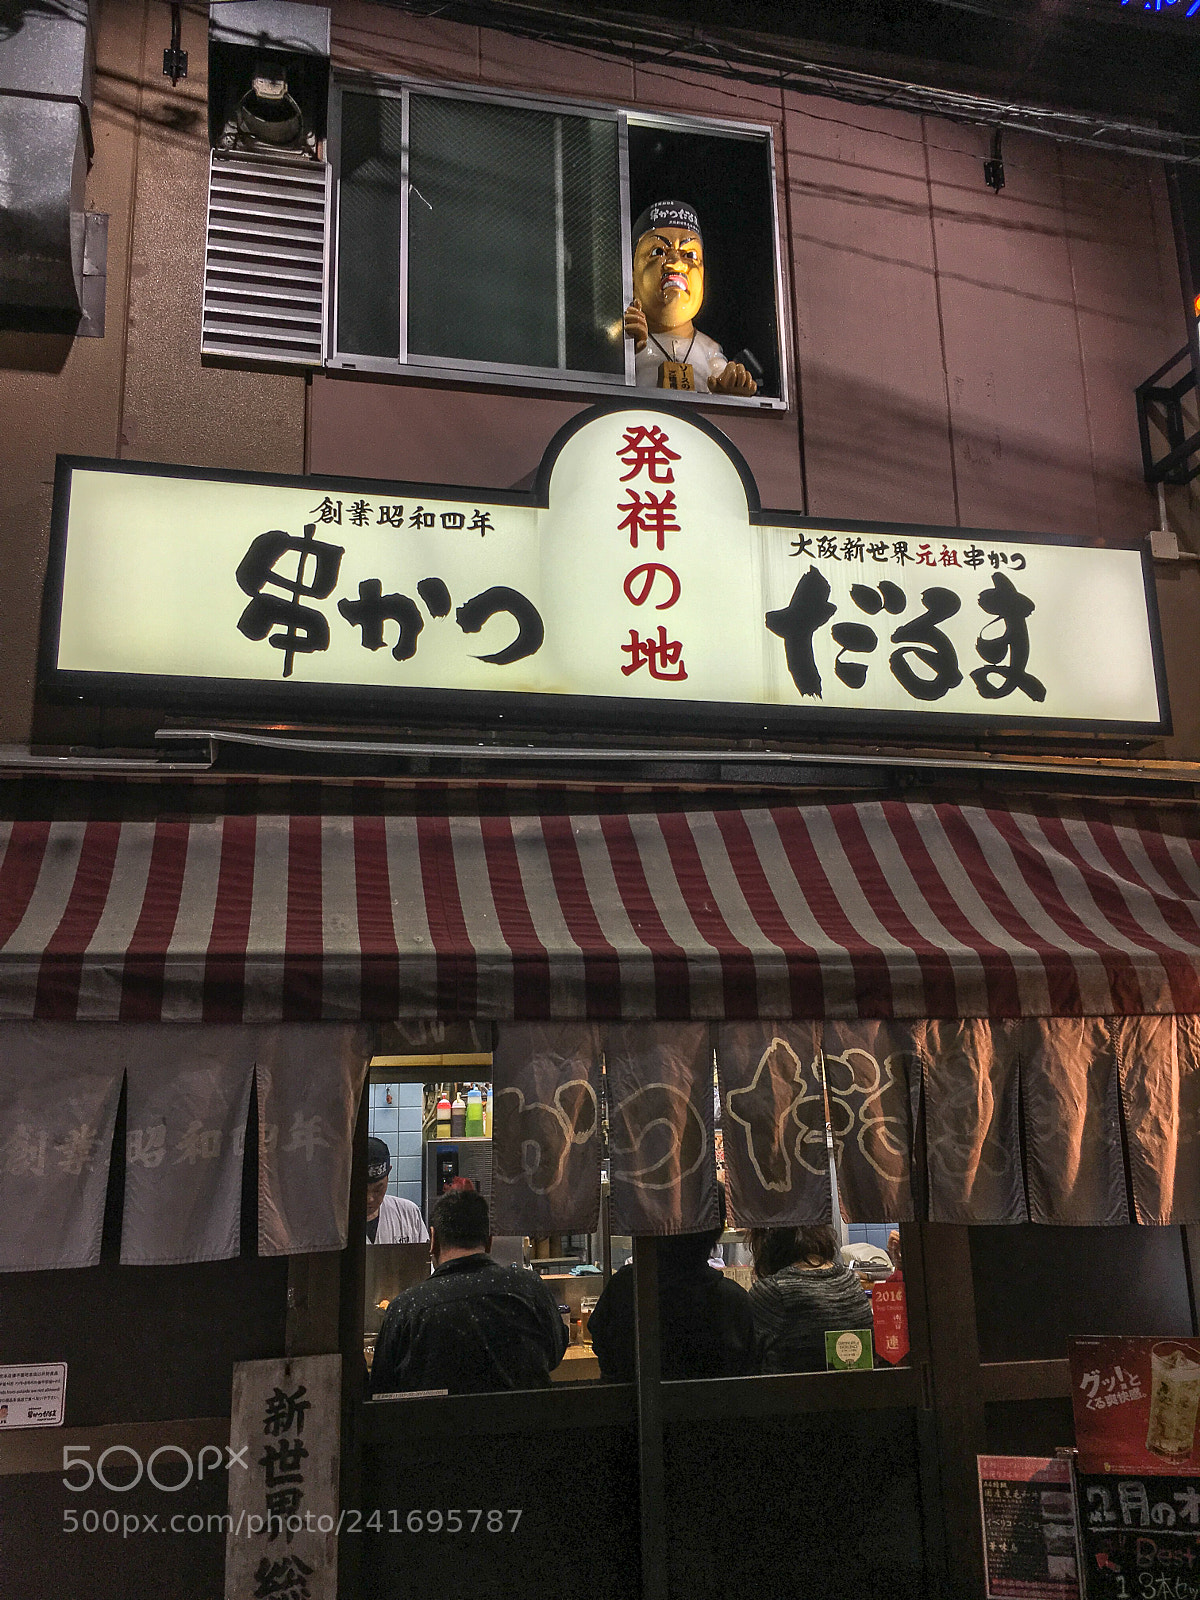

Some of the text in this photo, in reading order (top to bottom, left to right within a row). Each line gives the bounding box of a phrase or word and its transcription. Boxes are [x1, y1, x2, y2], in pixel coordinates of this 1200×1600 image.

[309, 496, 496, 538] 創業昭和四年
[616, 424, 689, 682] 発祥の地
[788, 532, 1027, 572] 大阪新世界元祖串かつ
[235, 524, 546, 678] 串かつ
[766, 565, 1047, 703] だるま
